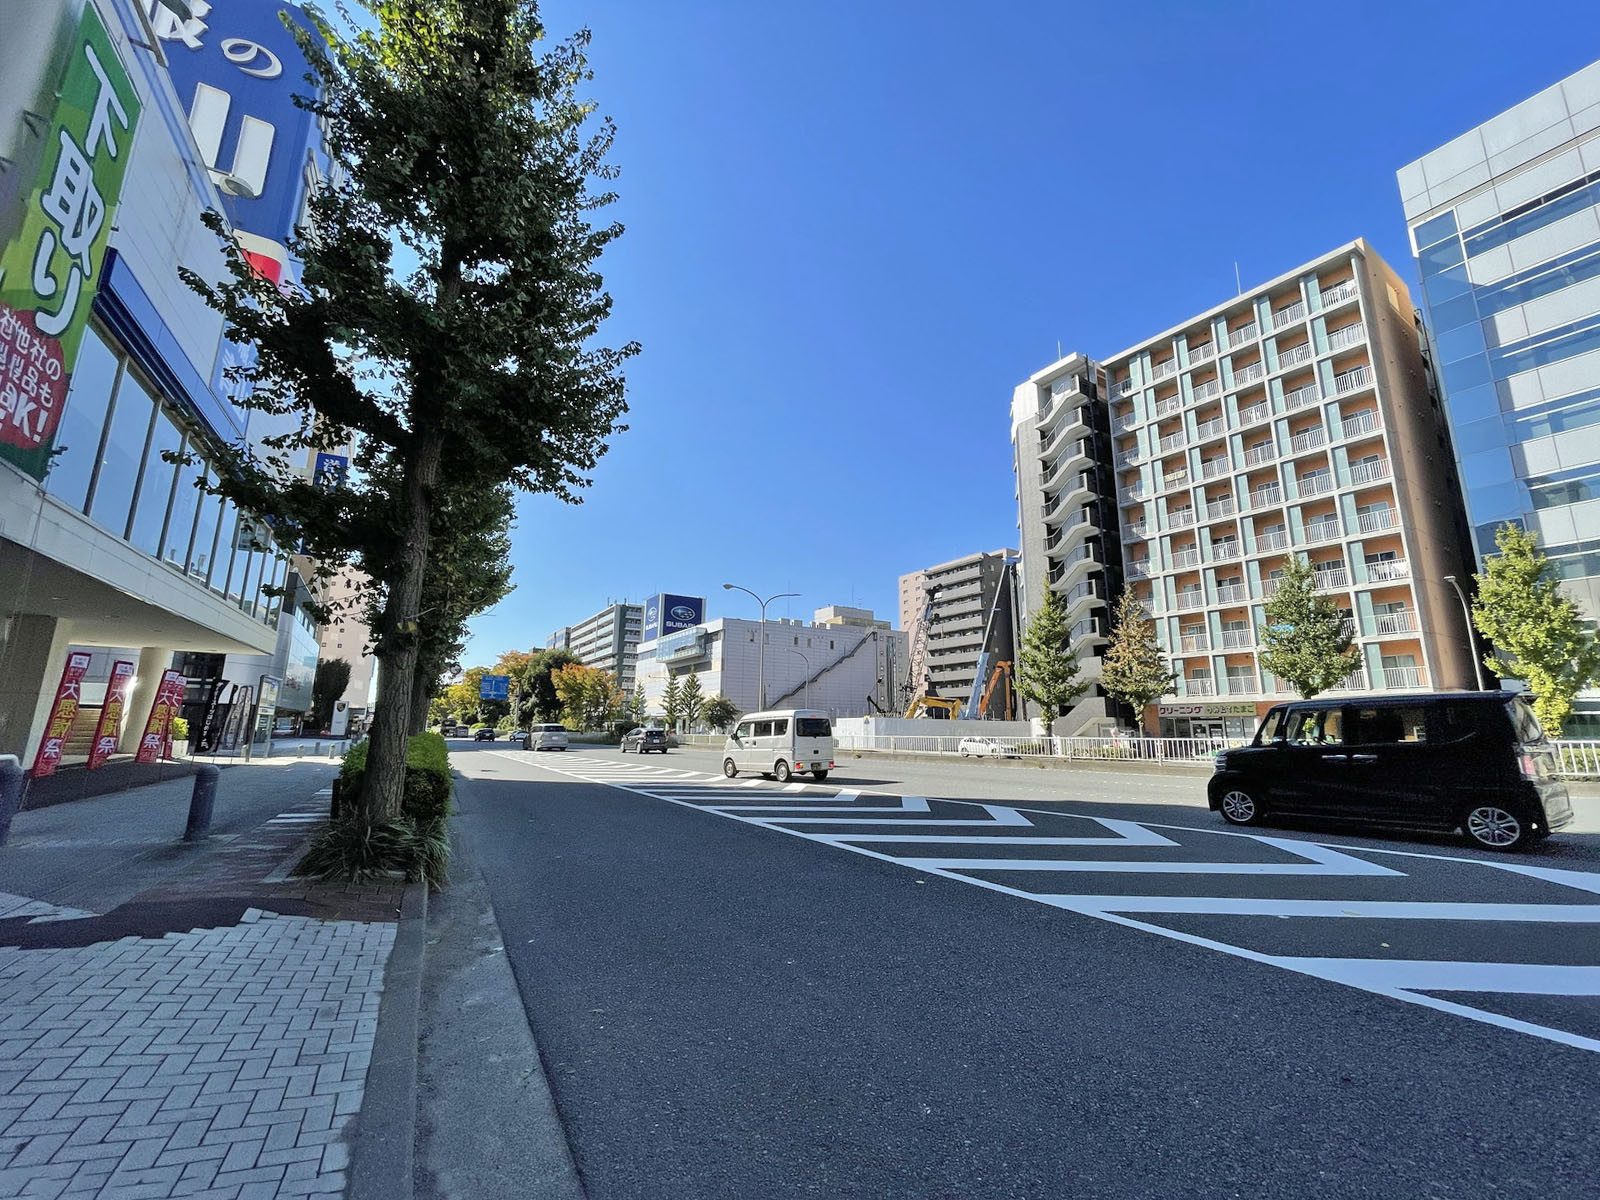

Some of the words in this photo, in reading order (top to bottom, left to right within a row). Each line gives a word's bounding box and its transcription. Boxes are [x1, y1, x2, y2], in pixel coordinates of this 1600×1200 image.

[34, 43, 130, 336] 下取り
[665, 620, 696, 630] SUBAR
[1159, 706, 1203, 715] クリーニング
